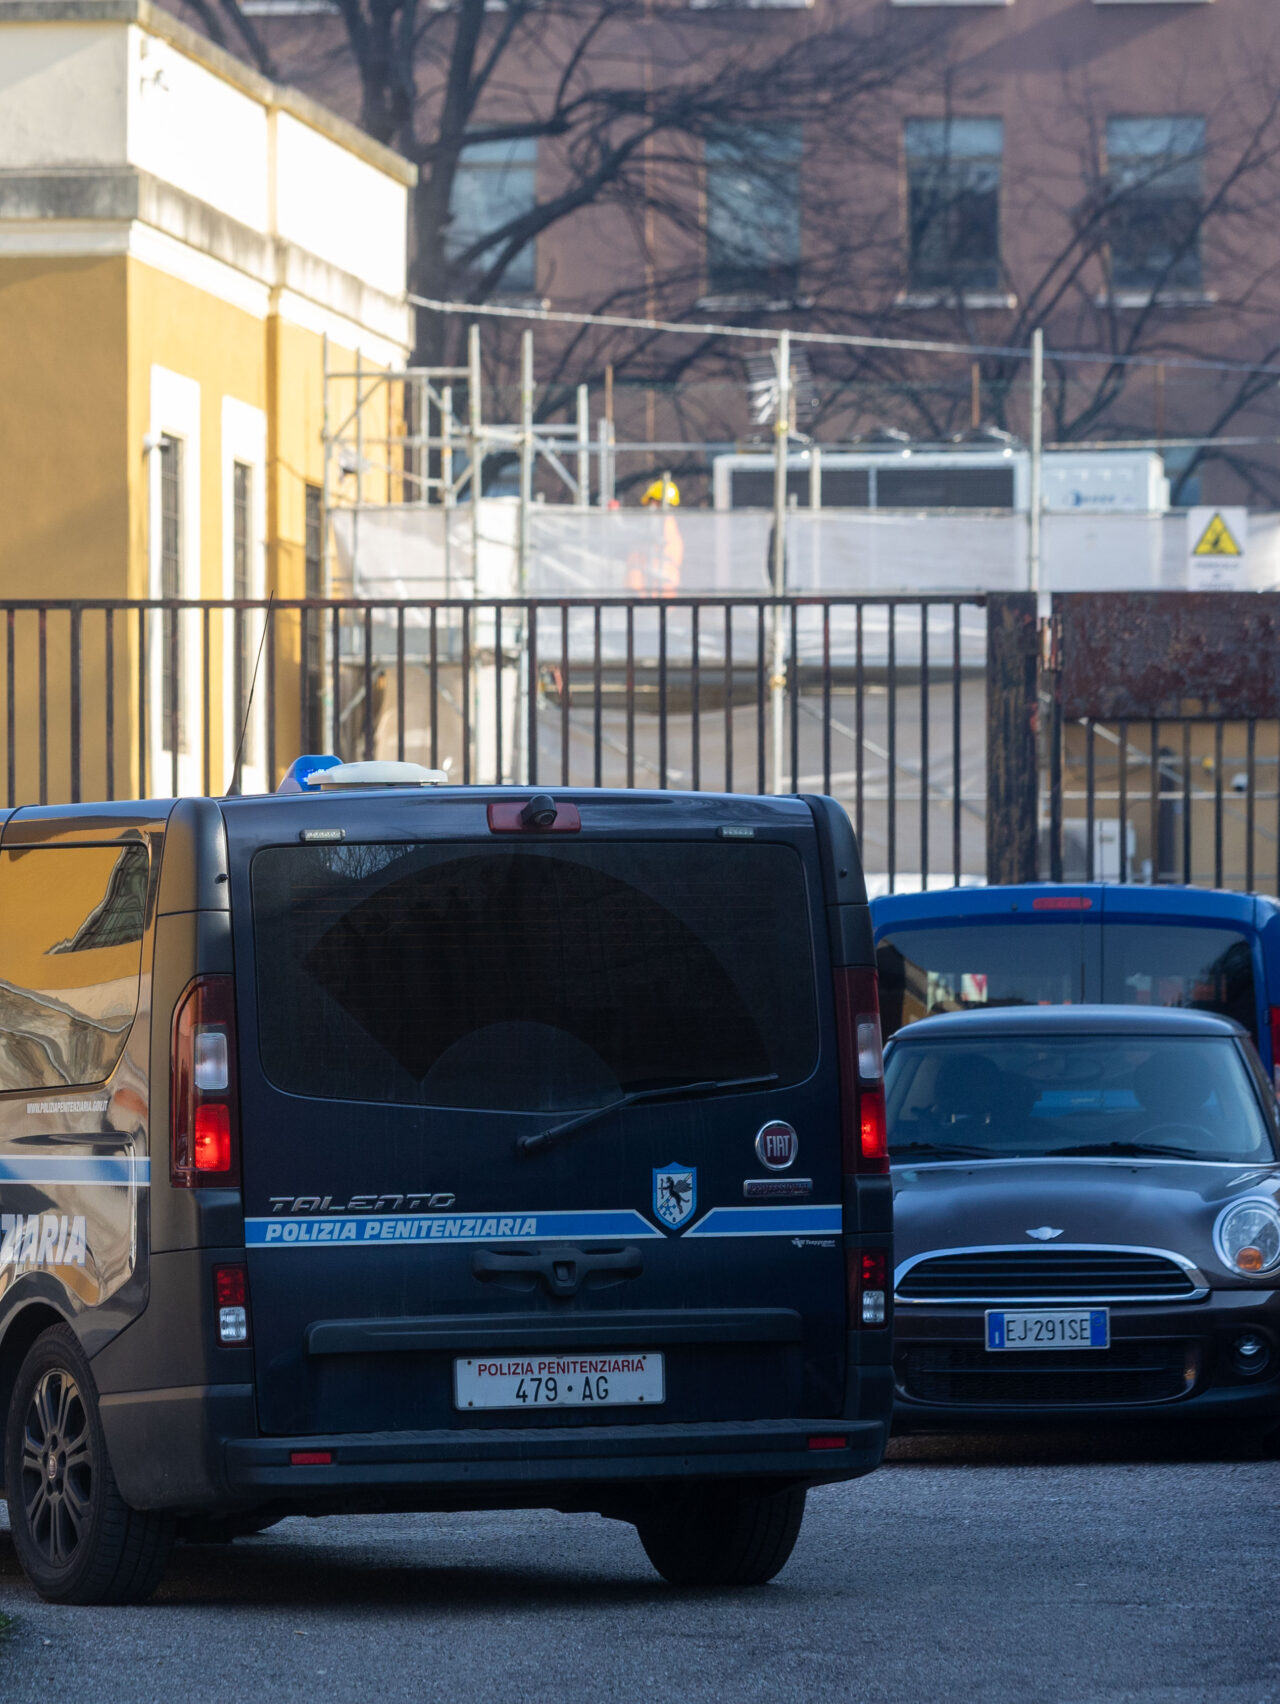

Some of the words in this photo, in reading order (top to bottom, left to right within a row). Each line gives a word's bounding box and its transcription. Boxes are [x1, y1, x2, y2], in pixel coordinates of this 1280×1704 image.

[766, 1135, 790, 1157] FIAT
[269, 1193, 456, 1212] TALENTO
[265, 1221, 357, 1242] POLIZIA
[363, 1218, 537, 1240] PENITENZIARIA
[477, 1362, 534, 1376] POLIZIA
[538, 1359, 645, 1375] PENITENZIARIA
[515, 1377, 559, 1403] 479
[582, 1376, 609, 1401] AG
